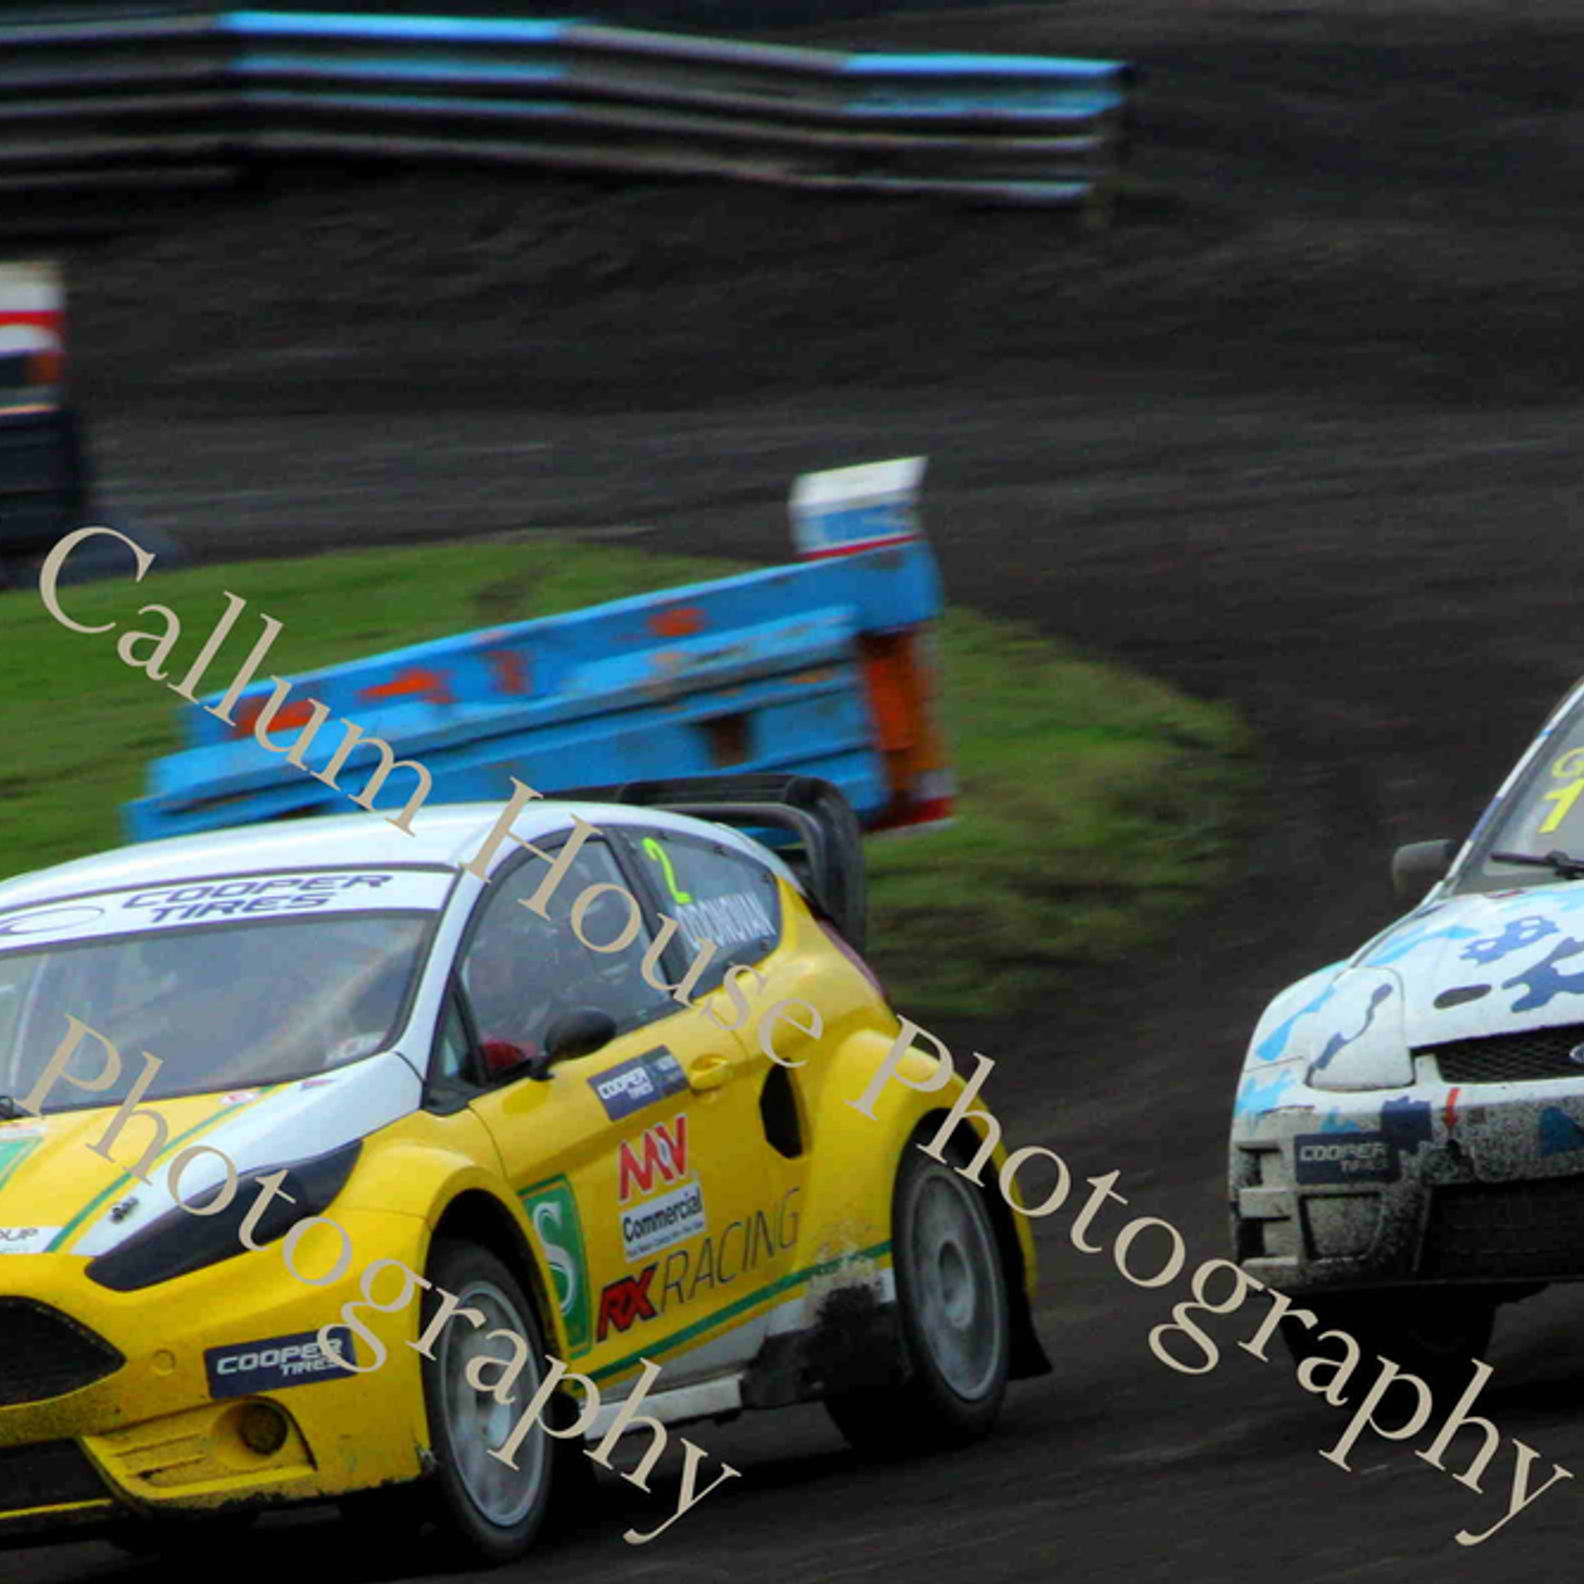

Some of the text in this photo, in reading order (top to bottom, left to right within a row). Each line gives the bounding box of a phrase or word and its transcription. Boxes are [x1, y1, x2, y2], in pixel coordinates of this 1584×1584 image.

[122, 874, 393, 910] COOPER
[641, 837, 692, 904] 2
[149, 890, 337, 924] TIRES
[623, 1185, 703, 1243] Commercial
[533, 1201, 577, 1316] S
[597, 1187, 801, 1343] RX RACING
